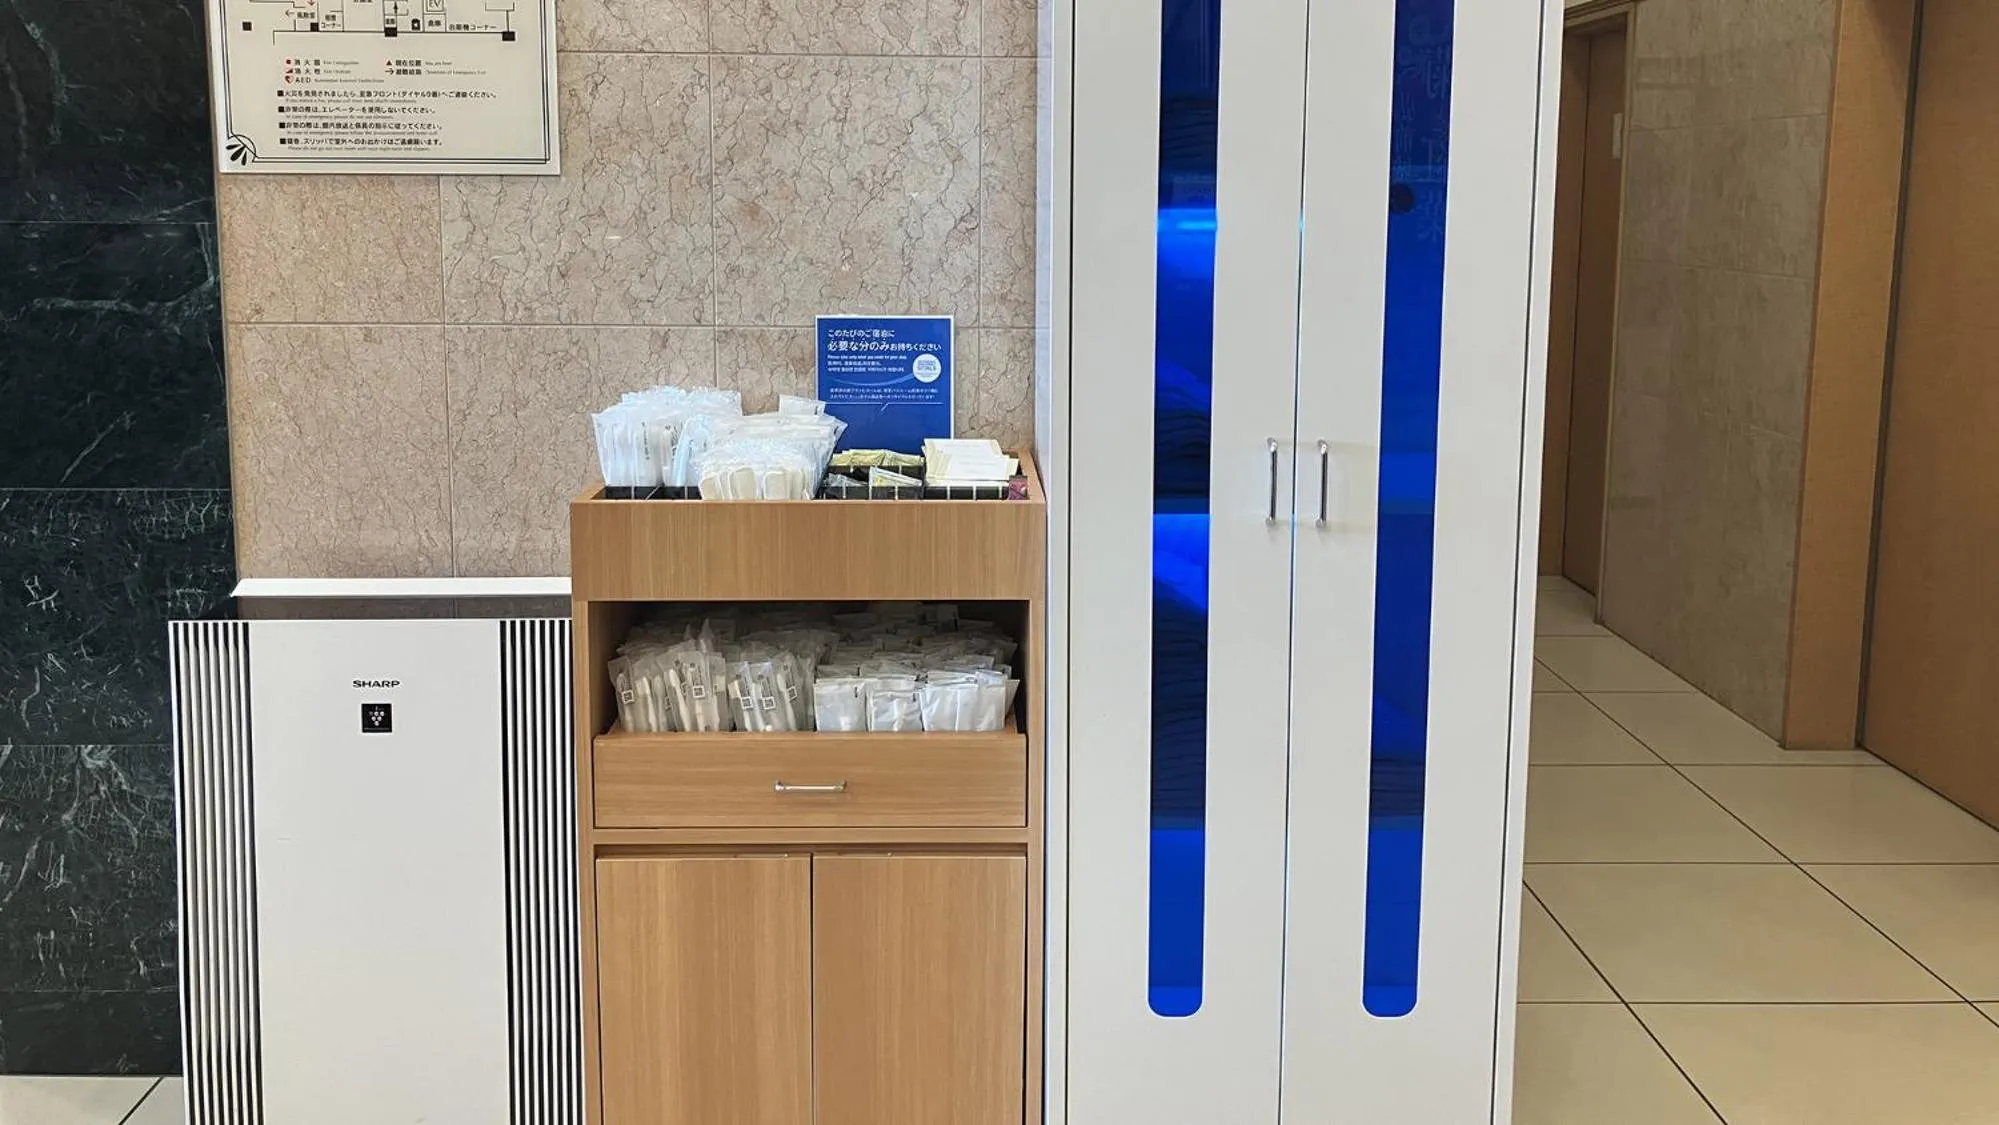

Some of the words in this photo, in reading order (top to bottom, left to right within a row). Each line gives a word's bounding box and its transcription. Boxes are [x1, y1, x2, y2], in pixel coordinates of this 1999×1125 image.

[827, 340, 942, 352] 必要な分のみお持ちください
[353, 680, 400, 688] SHARP
